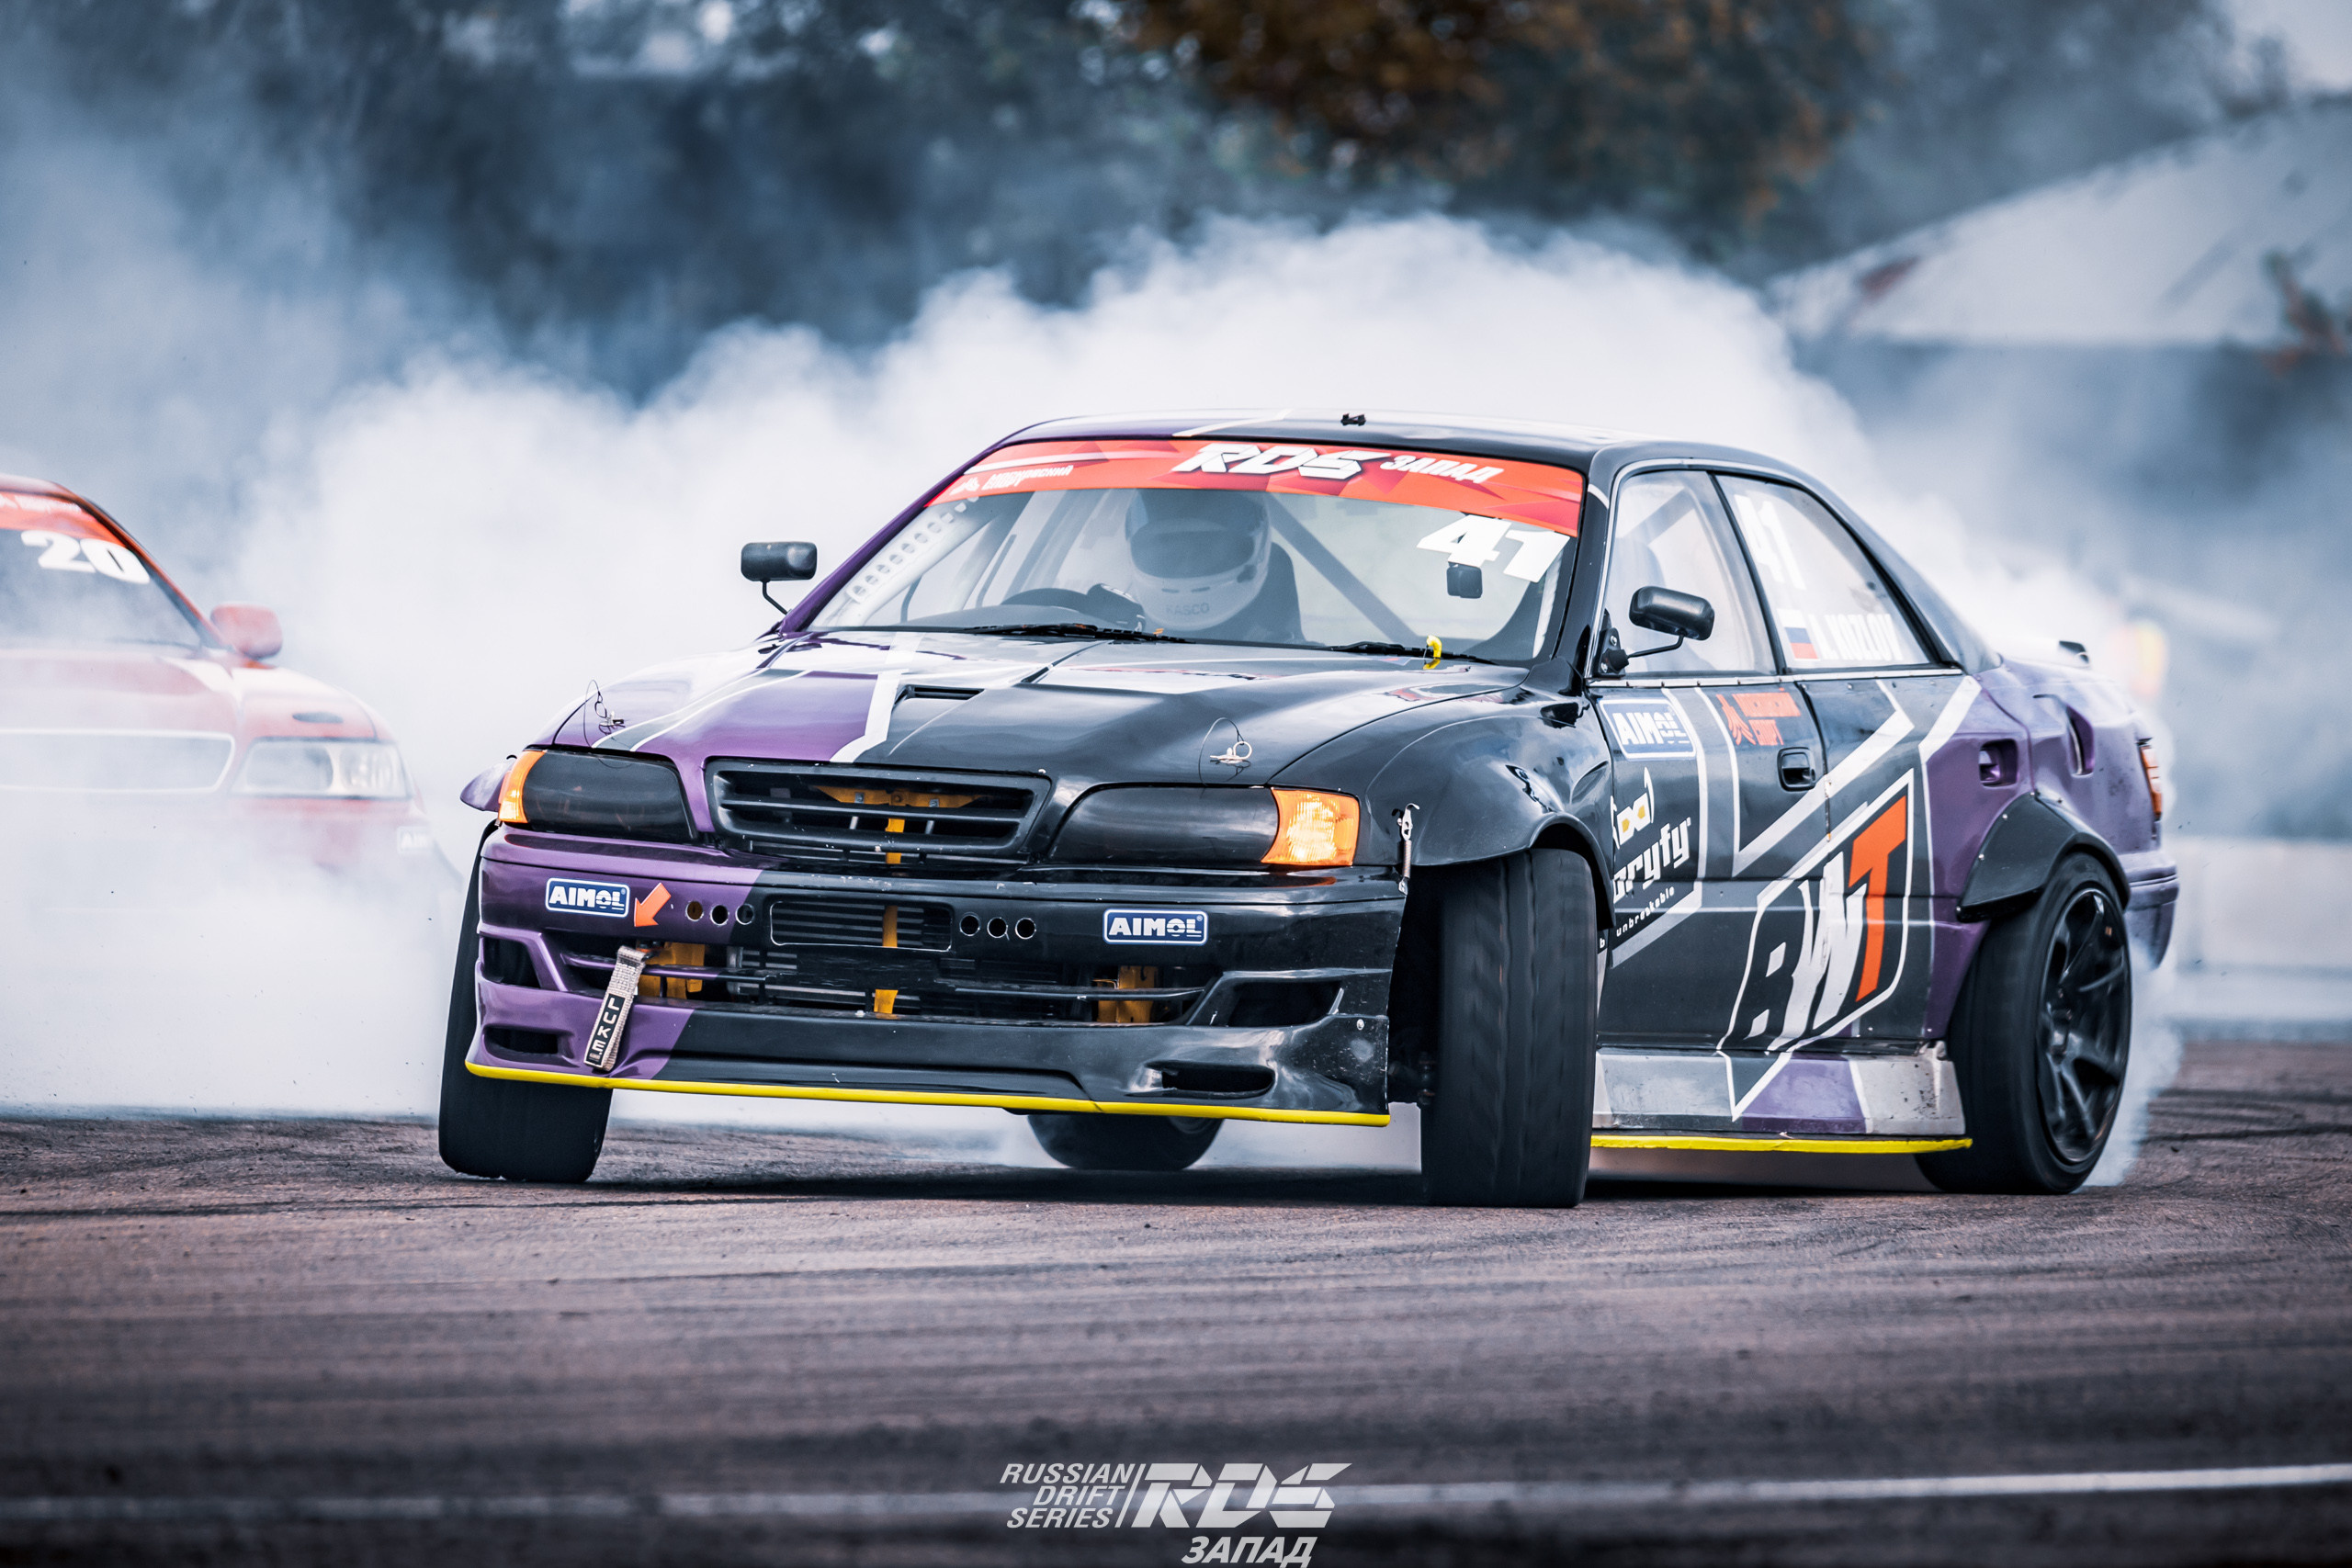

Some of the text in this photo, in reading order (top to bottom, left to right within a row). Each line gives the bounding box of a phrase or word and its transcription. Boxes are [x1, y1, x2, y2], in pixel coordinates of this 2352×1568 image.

[1171, 443, 1391, 480] RDS
[20, 529, 151, 584] 20
[1416, 513, 1571, 583] 41
[1735, 494, 1807, 591] 41
[1823, 612, 1905, 661] KOZLOV
[1611, 712, 1690, 745] AIMOL
[1613, 819, 1690, 905] oryfy
[548, 886, 625, 911] AIMOL
[1616, 886, 1675, 937] unbreakable
[1108, 917, 1203, 938] AIMOL
